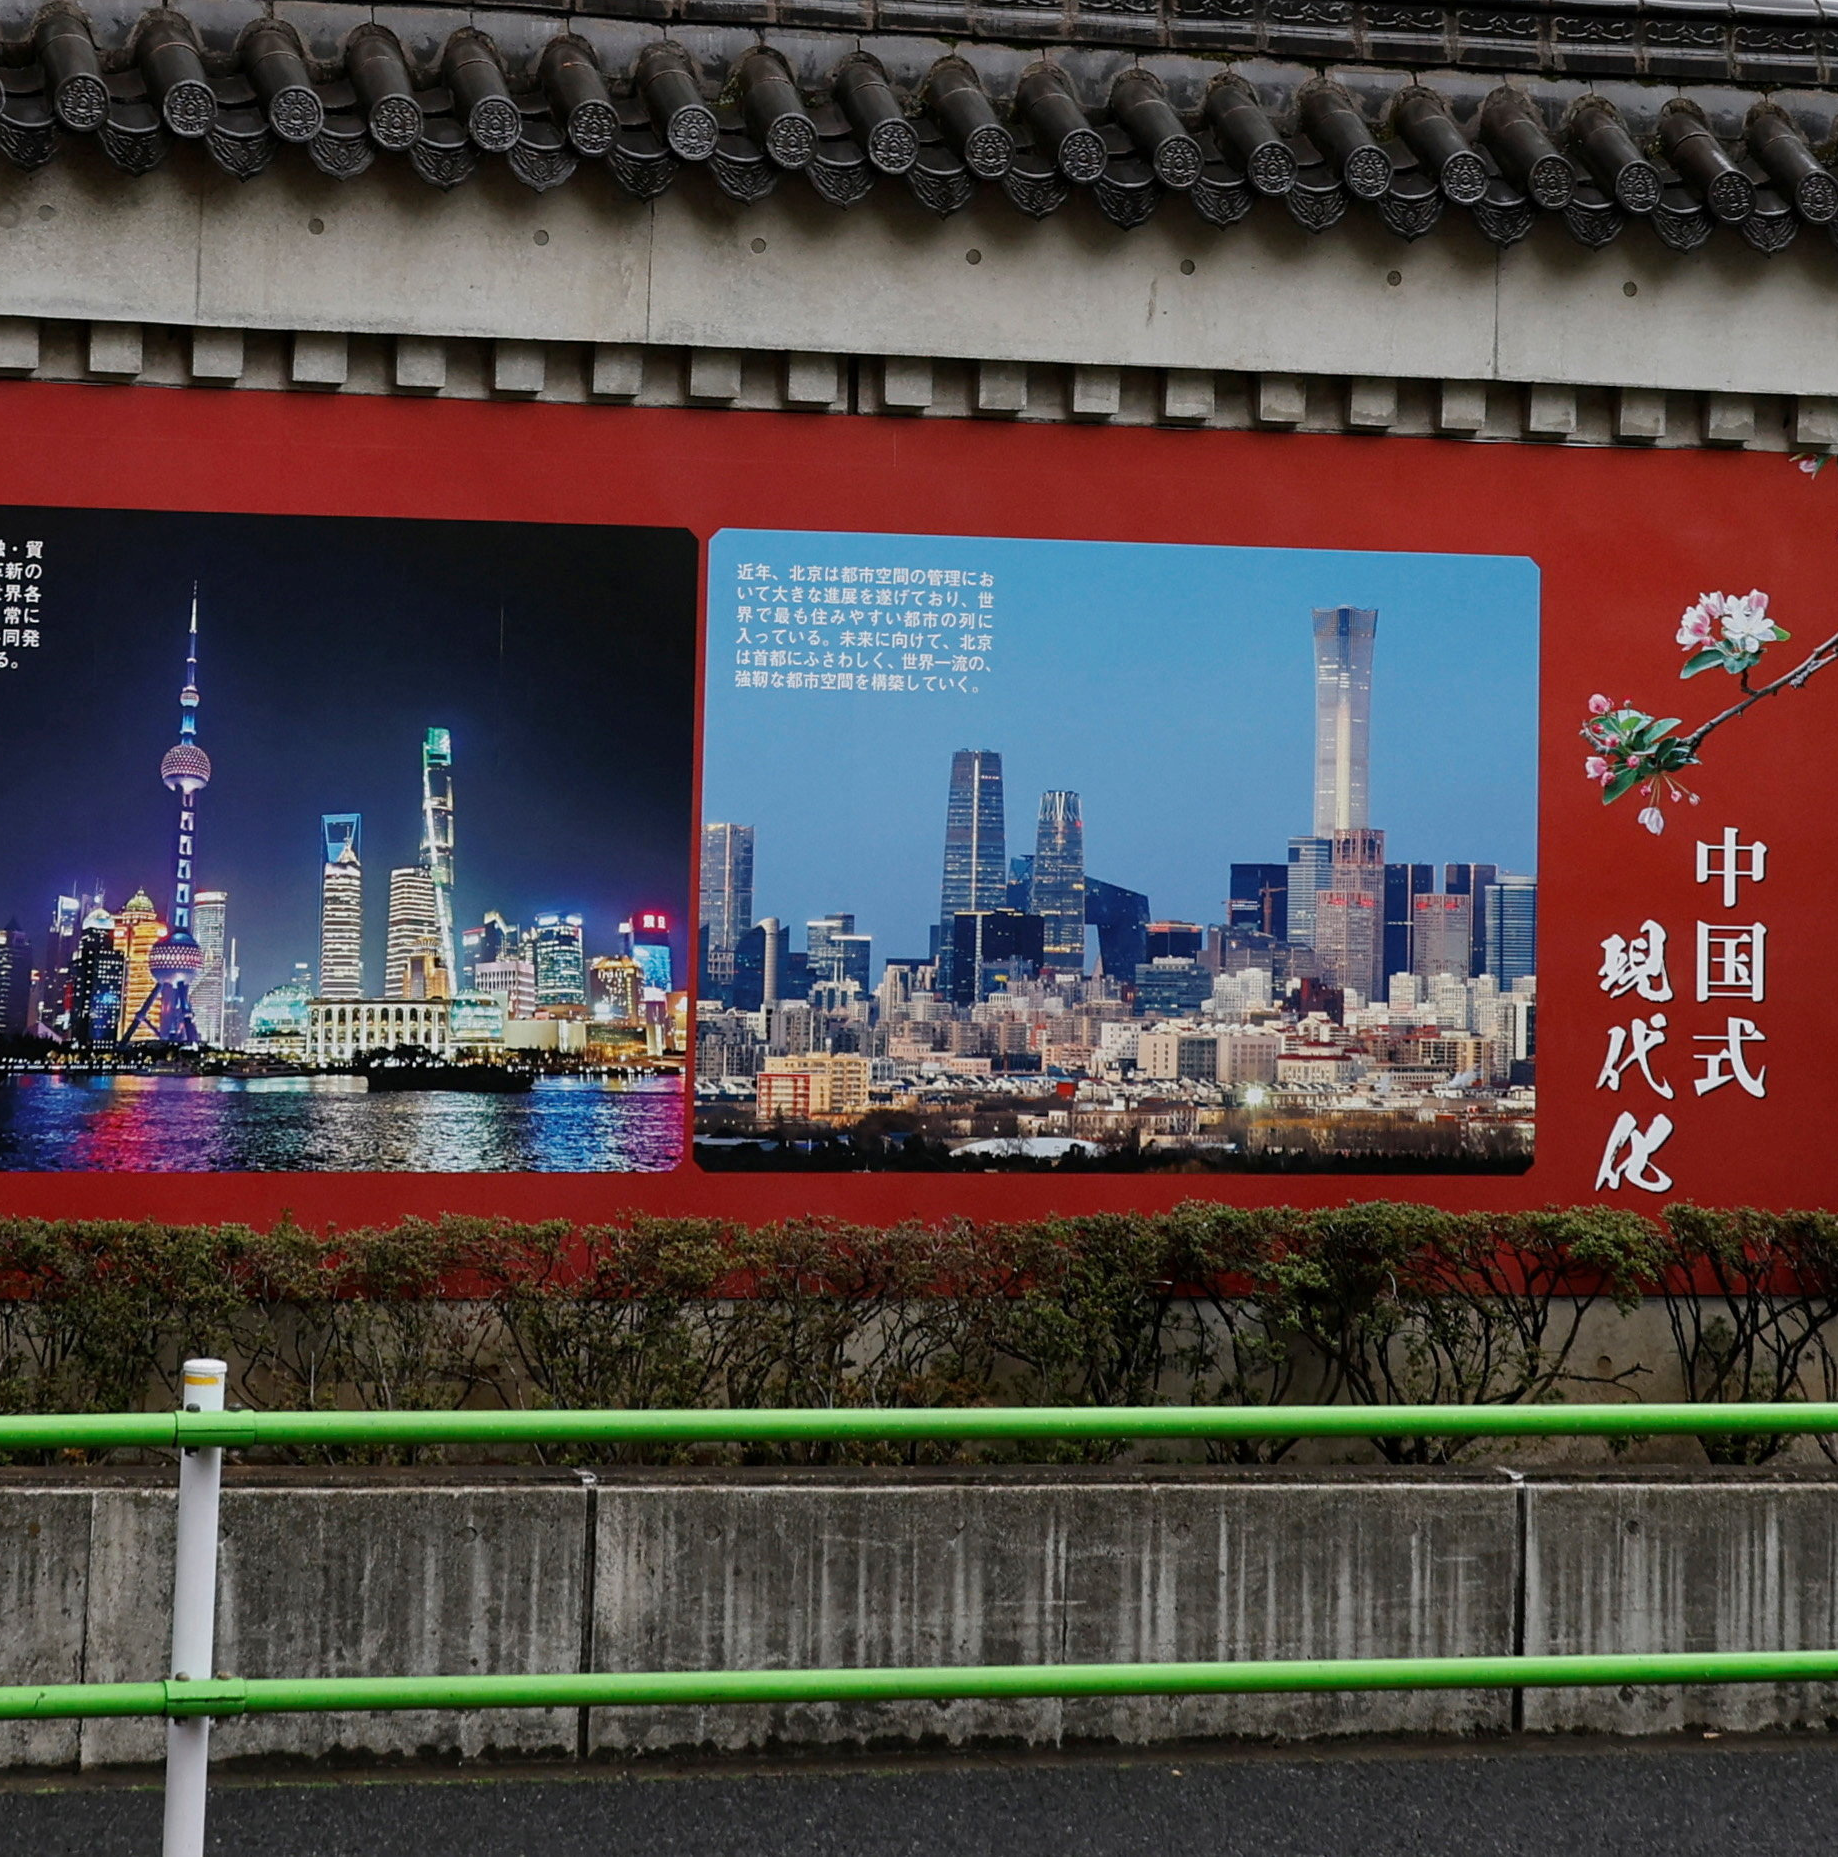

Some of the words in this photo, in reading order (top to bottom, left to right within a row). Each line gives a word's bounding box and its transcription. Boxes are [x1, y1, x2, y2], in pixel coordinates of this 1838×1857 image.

[736, 563, 995, 587] 近年、北京は都市空間の管理にお
[737, 586, 994, 609] いて大きな進展を遂げており、世
[736, 606, 993, 630] 界で最も住みやすい都市の列に
[735, 627, 993, 651] 入っている。未来に向けて、北京
[736, 649, 992, 673] は首都にふさわしく、世界一流の、
[1692, 827, 1768, 1098] 中国式
[1596, 919, 1674, 1193] 現代化
